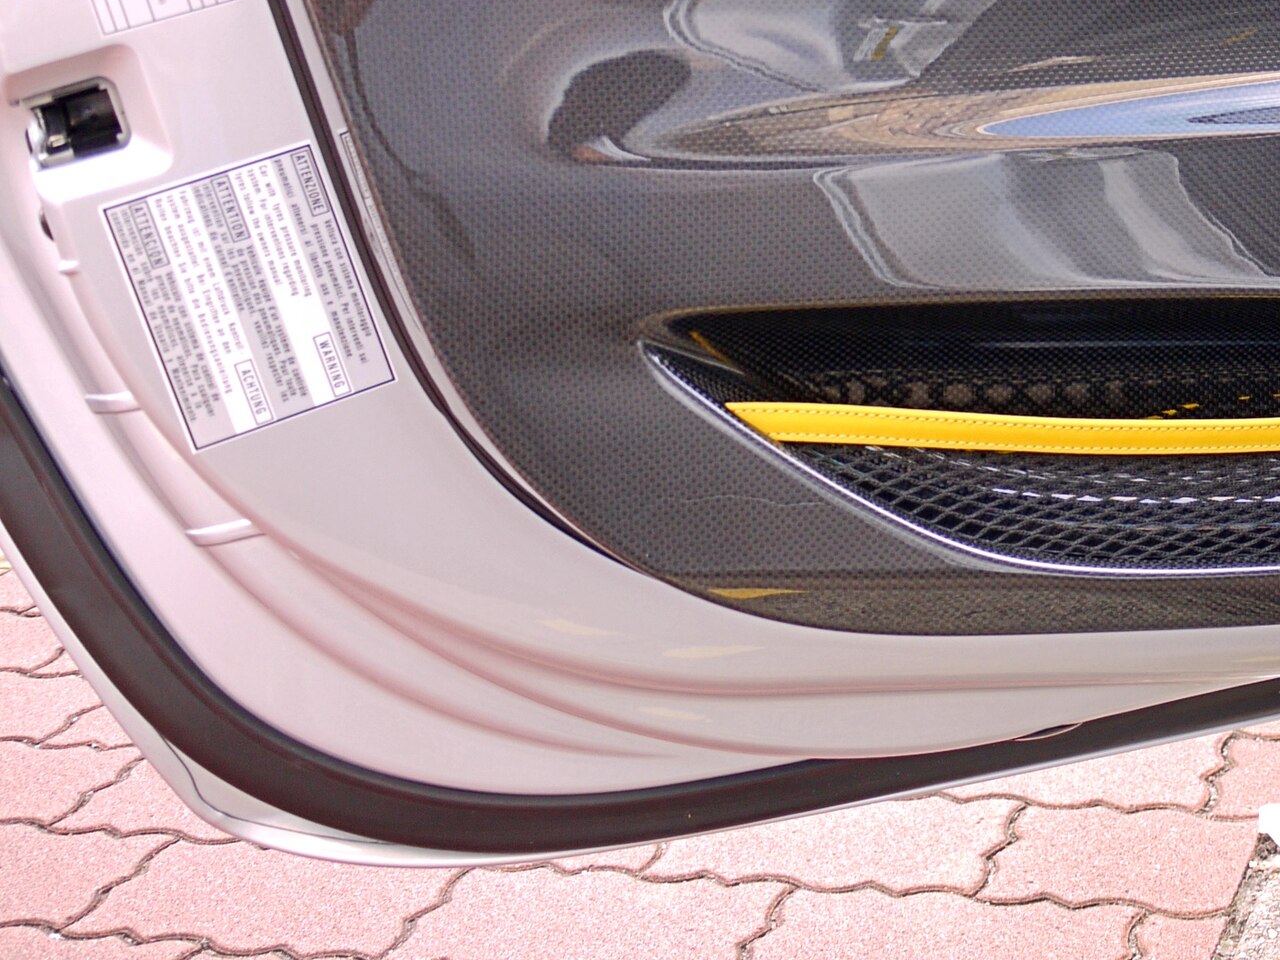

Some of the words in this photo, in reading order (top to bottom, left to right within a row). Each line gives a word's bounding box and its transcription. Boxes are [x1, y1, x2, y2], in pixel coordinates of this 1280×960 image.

[257, 163, 270, 178] Car
[263, 181, 276, 197] with
[293, 152, 325, 211] ATTENZIONE
[214, 179, 246, 239] ATTENTION
[232, 171, 248, 191] tyres
[250, 216, 263, 230] the
[270, 202, 286, 223] tyres
[278, 224, 298, 258] pressure
[278, 260, 300, 297] regarding
[290, 257, 314, 298] monitoring
[309, 222, 329, 258] pressione
[339, 301, 352, 315] Per
[338, 260, 356, 290] sistema
[317, 338, 346, 389] WARNING
[239, 367, 267, 415] ACHTUNG
